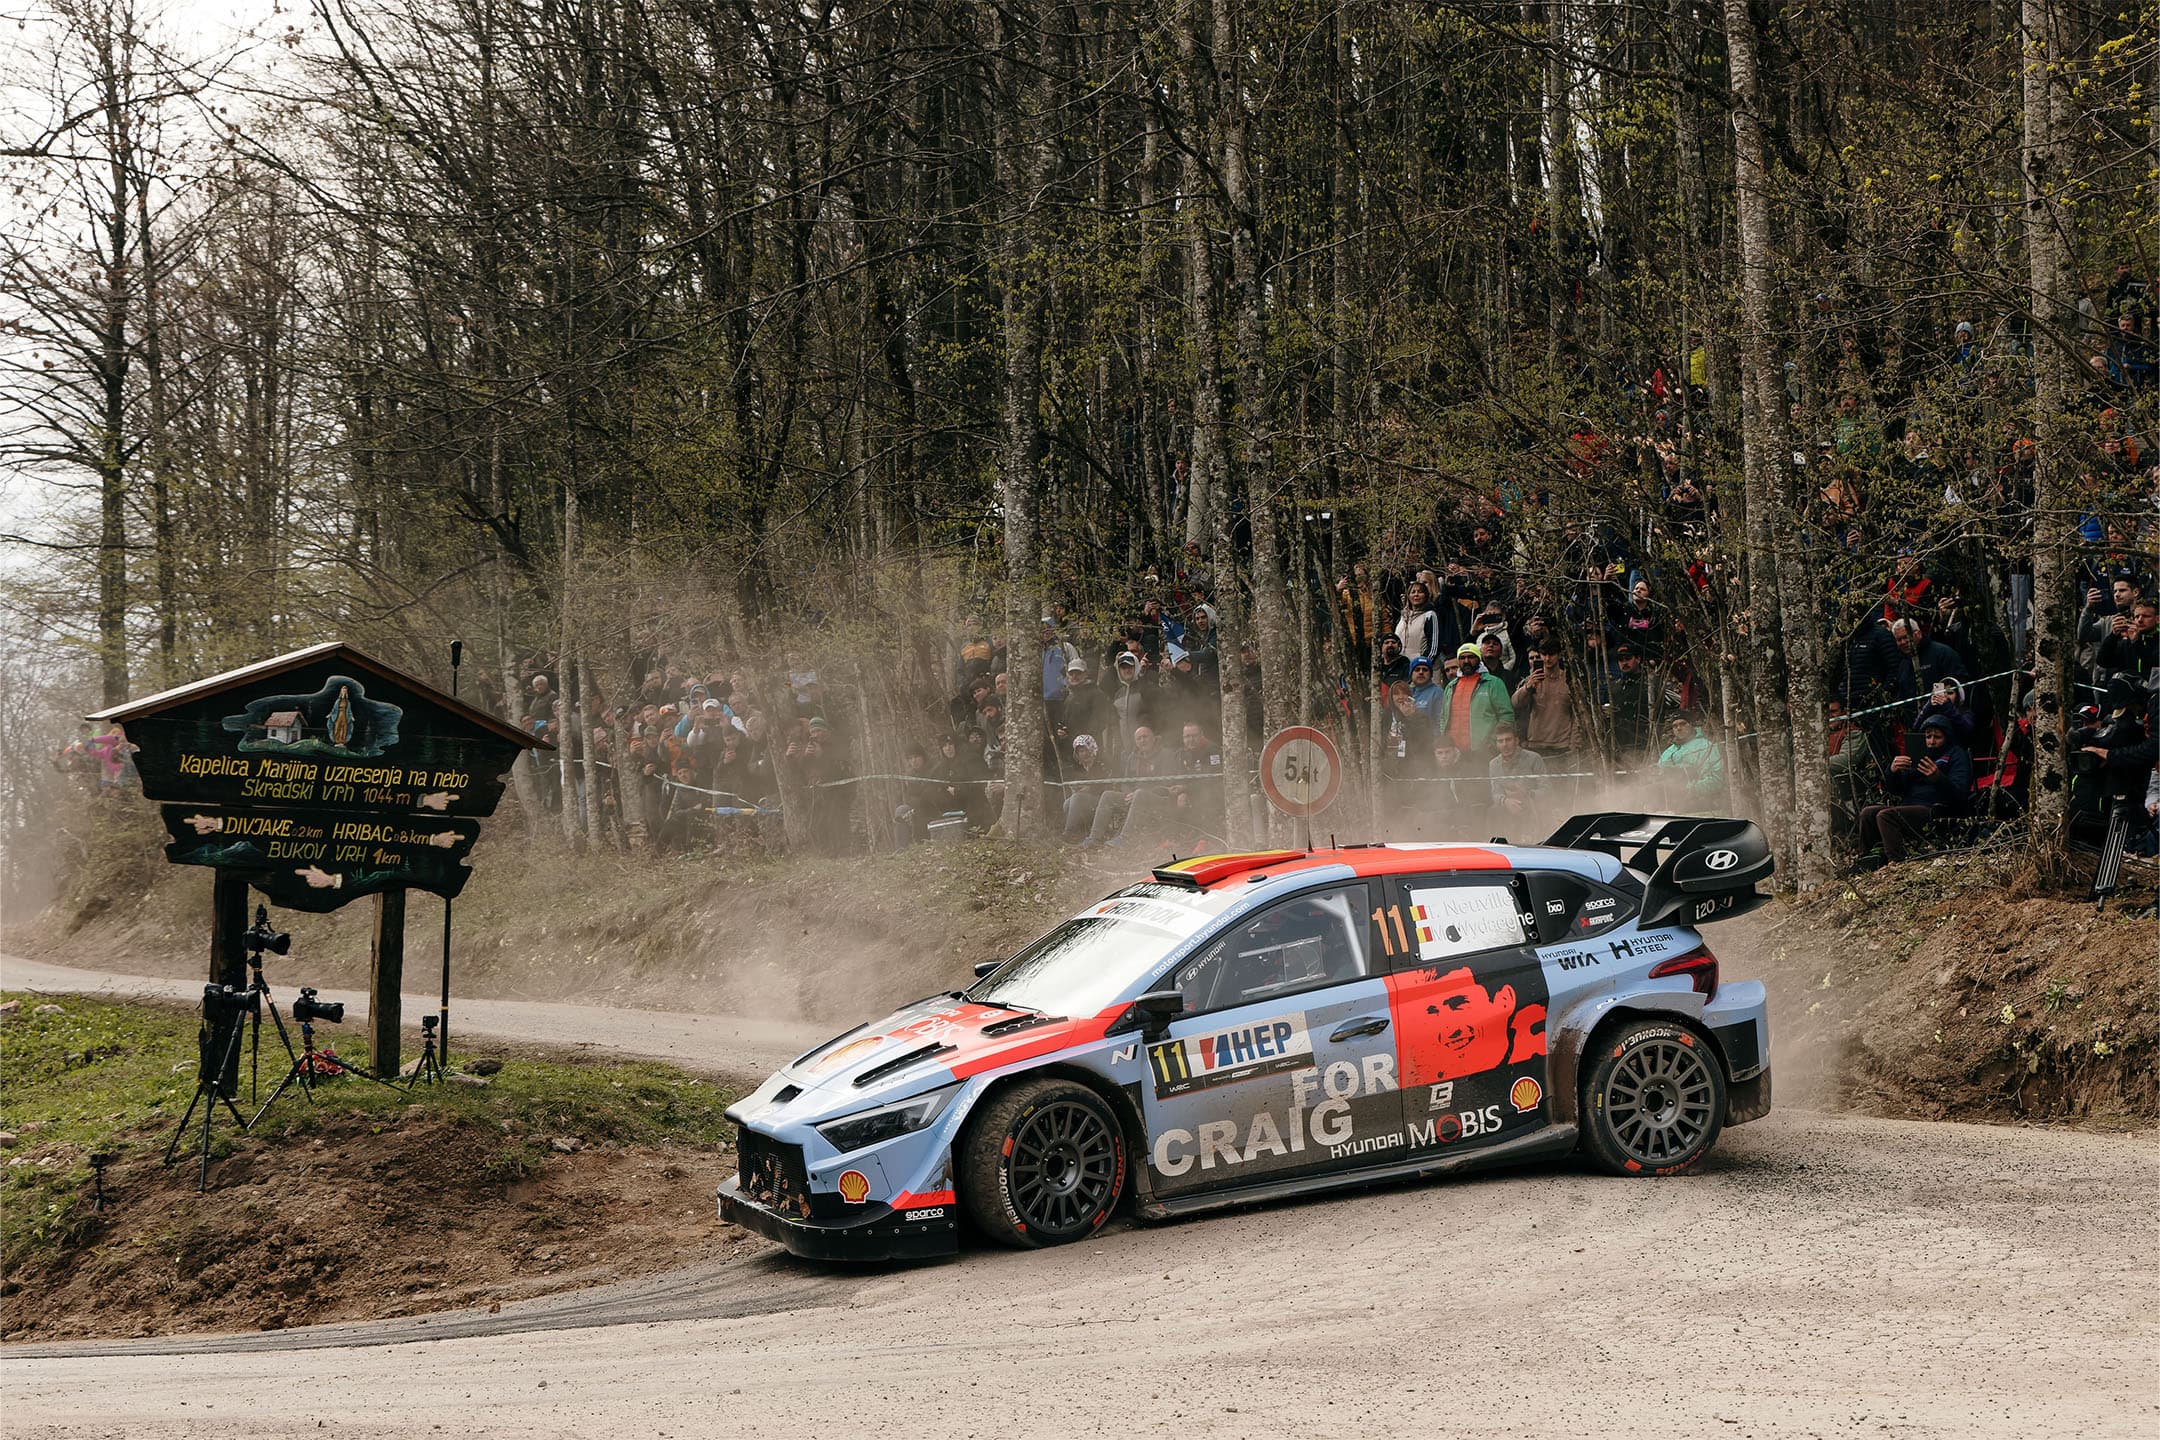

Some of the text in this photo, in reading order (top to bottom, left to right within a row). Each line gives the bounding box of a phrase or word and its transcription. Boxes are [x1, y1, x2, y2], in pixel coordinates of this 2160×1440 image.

[180, 754, 469, 788] Kapelica Marijina uznesenja na nebo
[241, 778, 315, 800] Skradski
[363, 788, 393, 804] 1044
[396, 792, 411, 805] m
[224, 816, 293, 837] DIVJAKE
[332, 822, 393, 842] HRIBAC
[267, 841, 328, 860] BUKOV
[336, 844, 368, 862] VRH
[1585, 898, 1616, 911] sparco
[1695, 899, 1716, 921] i20
[1151, 902, 1251, 978] motorsport.hyundai.com
[1371, 904, 1409, 956] 11
[1630, 934, 1674, 946] HYUNDAI
[1198, 941, 1227, 969] HYUNDAI
[1541, 948, 1577, 959] HYUNDAI
[1634, 943, 1668, 955] STEEL
[1231, 1021, 1292, 1063] HEP
[1153, 1041, 1188, 1083] 11
[1169, 1083, 1191, 1093] WRC
[1291, 1053, 1400, 1108] FOR
[1153, 1099, 1354, 1177] CRAIG
[1330, 1105, 1503, 1159] HYUNDAI MOBIS
[905, 1207, 945, 1221] sparco
